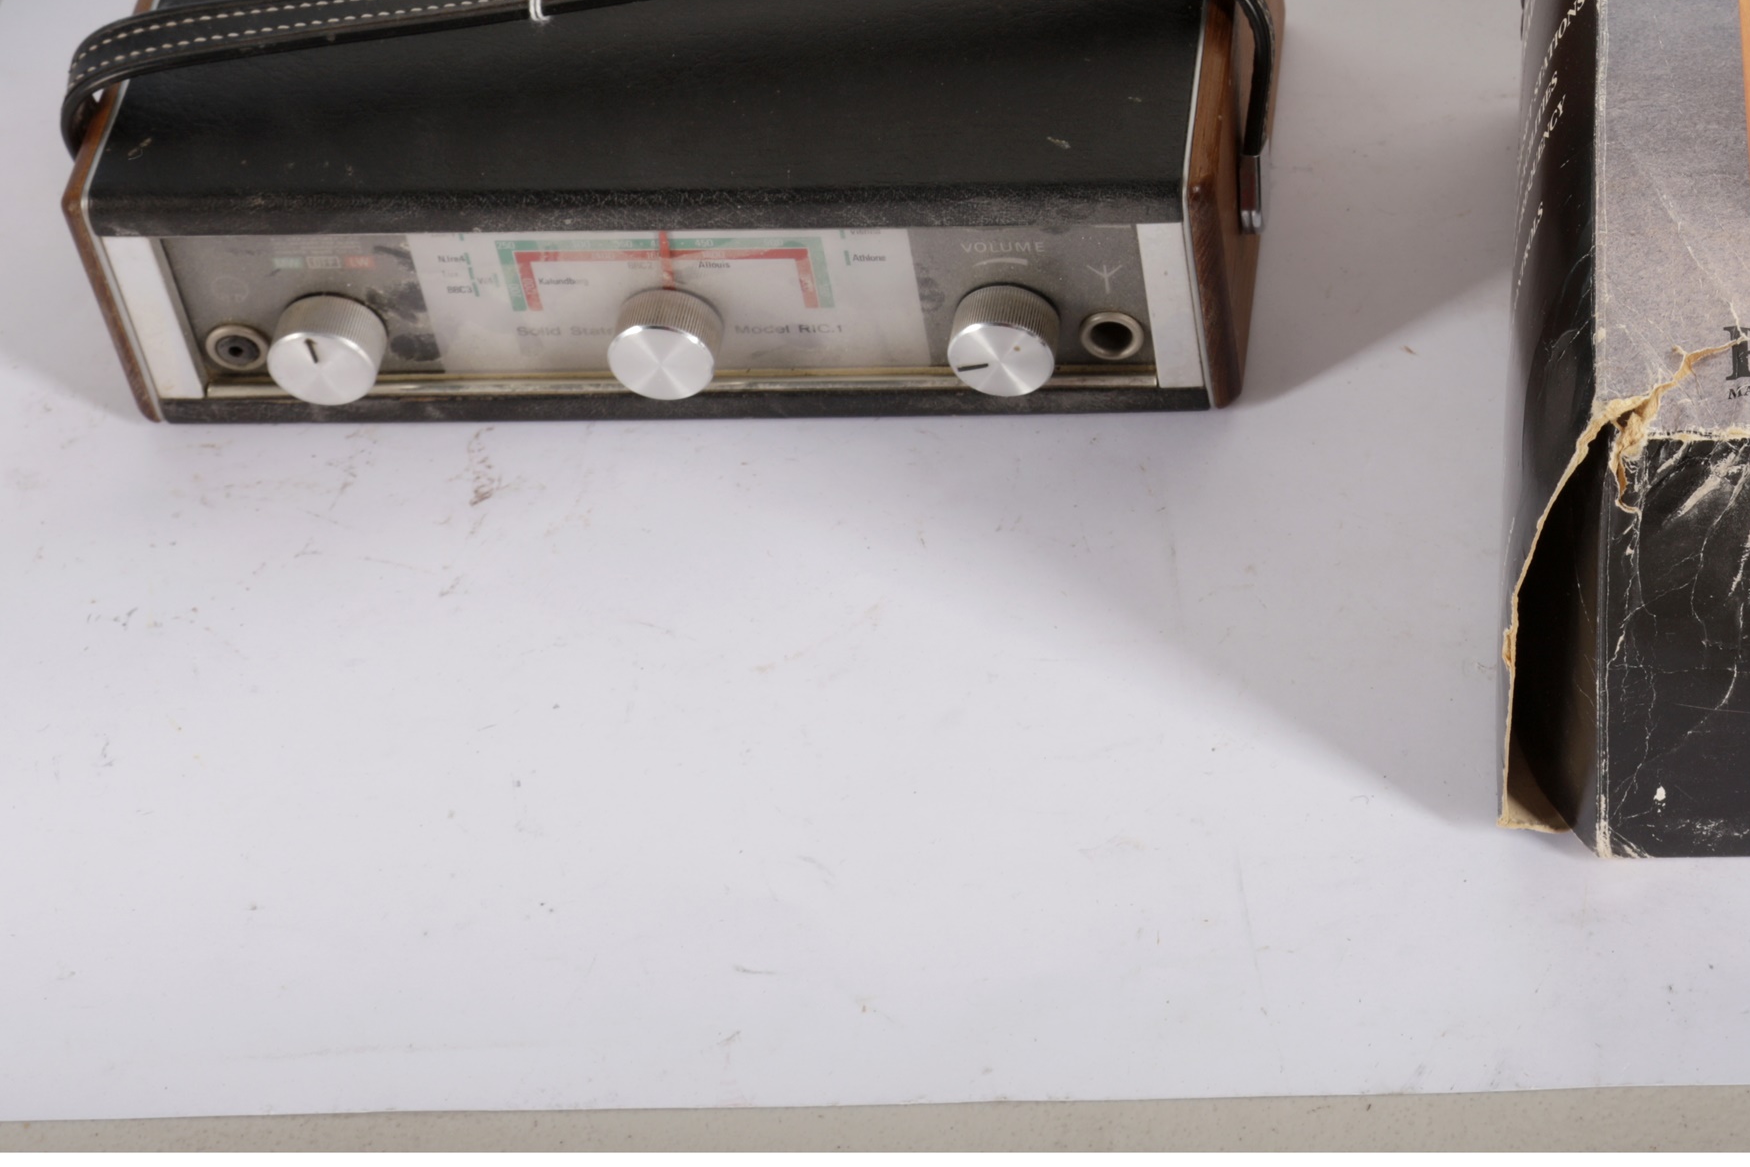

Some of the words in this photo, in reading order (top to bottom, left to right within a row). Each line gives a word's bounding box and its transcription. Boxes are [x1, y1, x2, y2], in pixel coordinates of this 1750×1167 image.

[961, 241, 1045, 253] VOLUME
[852, 253, 886, 262] Athlone
[698, 260, 731, 269] Allouis
[517, 326, 561, 336] Solid
[734, 324, 790, 334] Model
